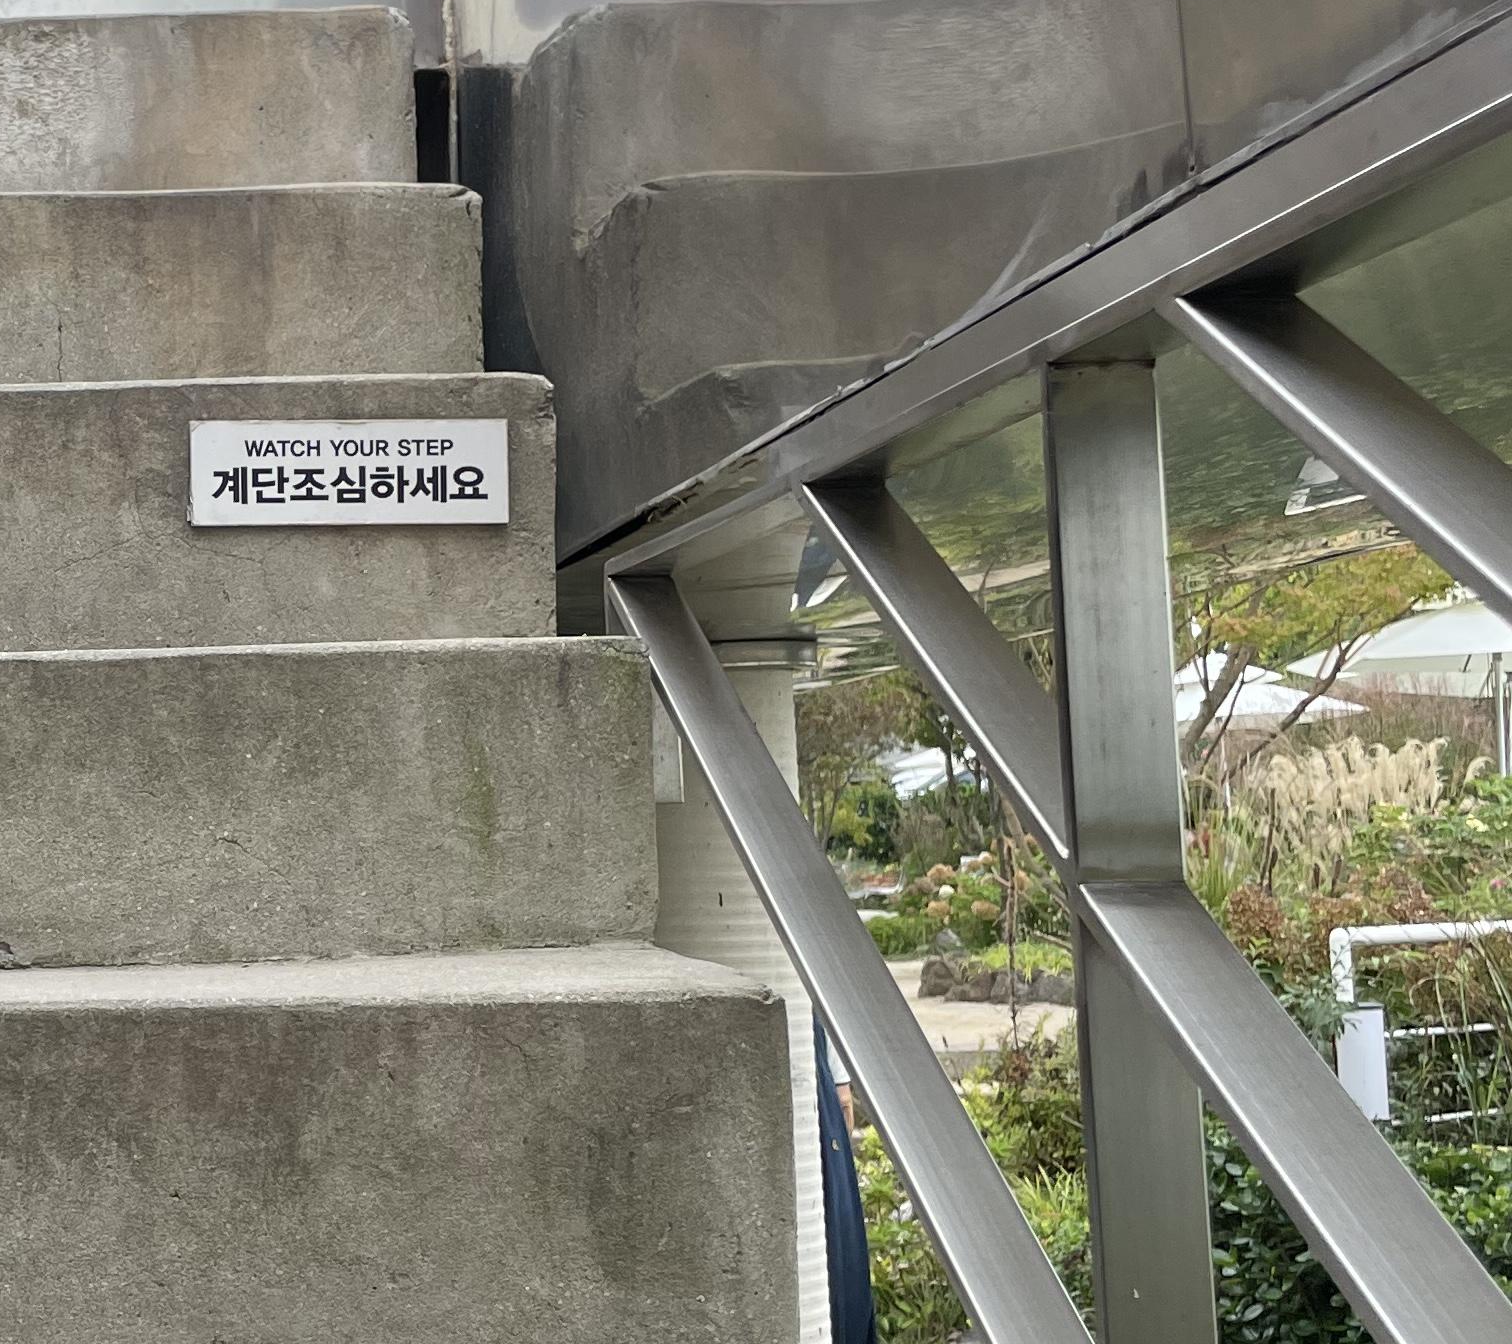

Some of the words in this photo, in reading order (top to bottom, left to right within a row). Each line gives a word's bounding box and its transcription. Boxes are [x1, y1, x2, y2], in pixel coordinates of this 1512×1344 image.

[244, 439, 321, 457] WATCH
[329, 439, 390, 457] YOUR
[397, 439, 454, 456] STEP
[212, 465, 489, 505] 계단조심하세요
